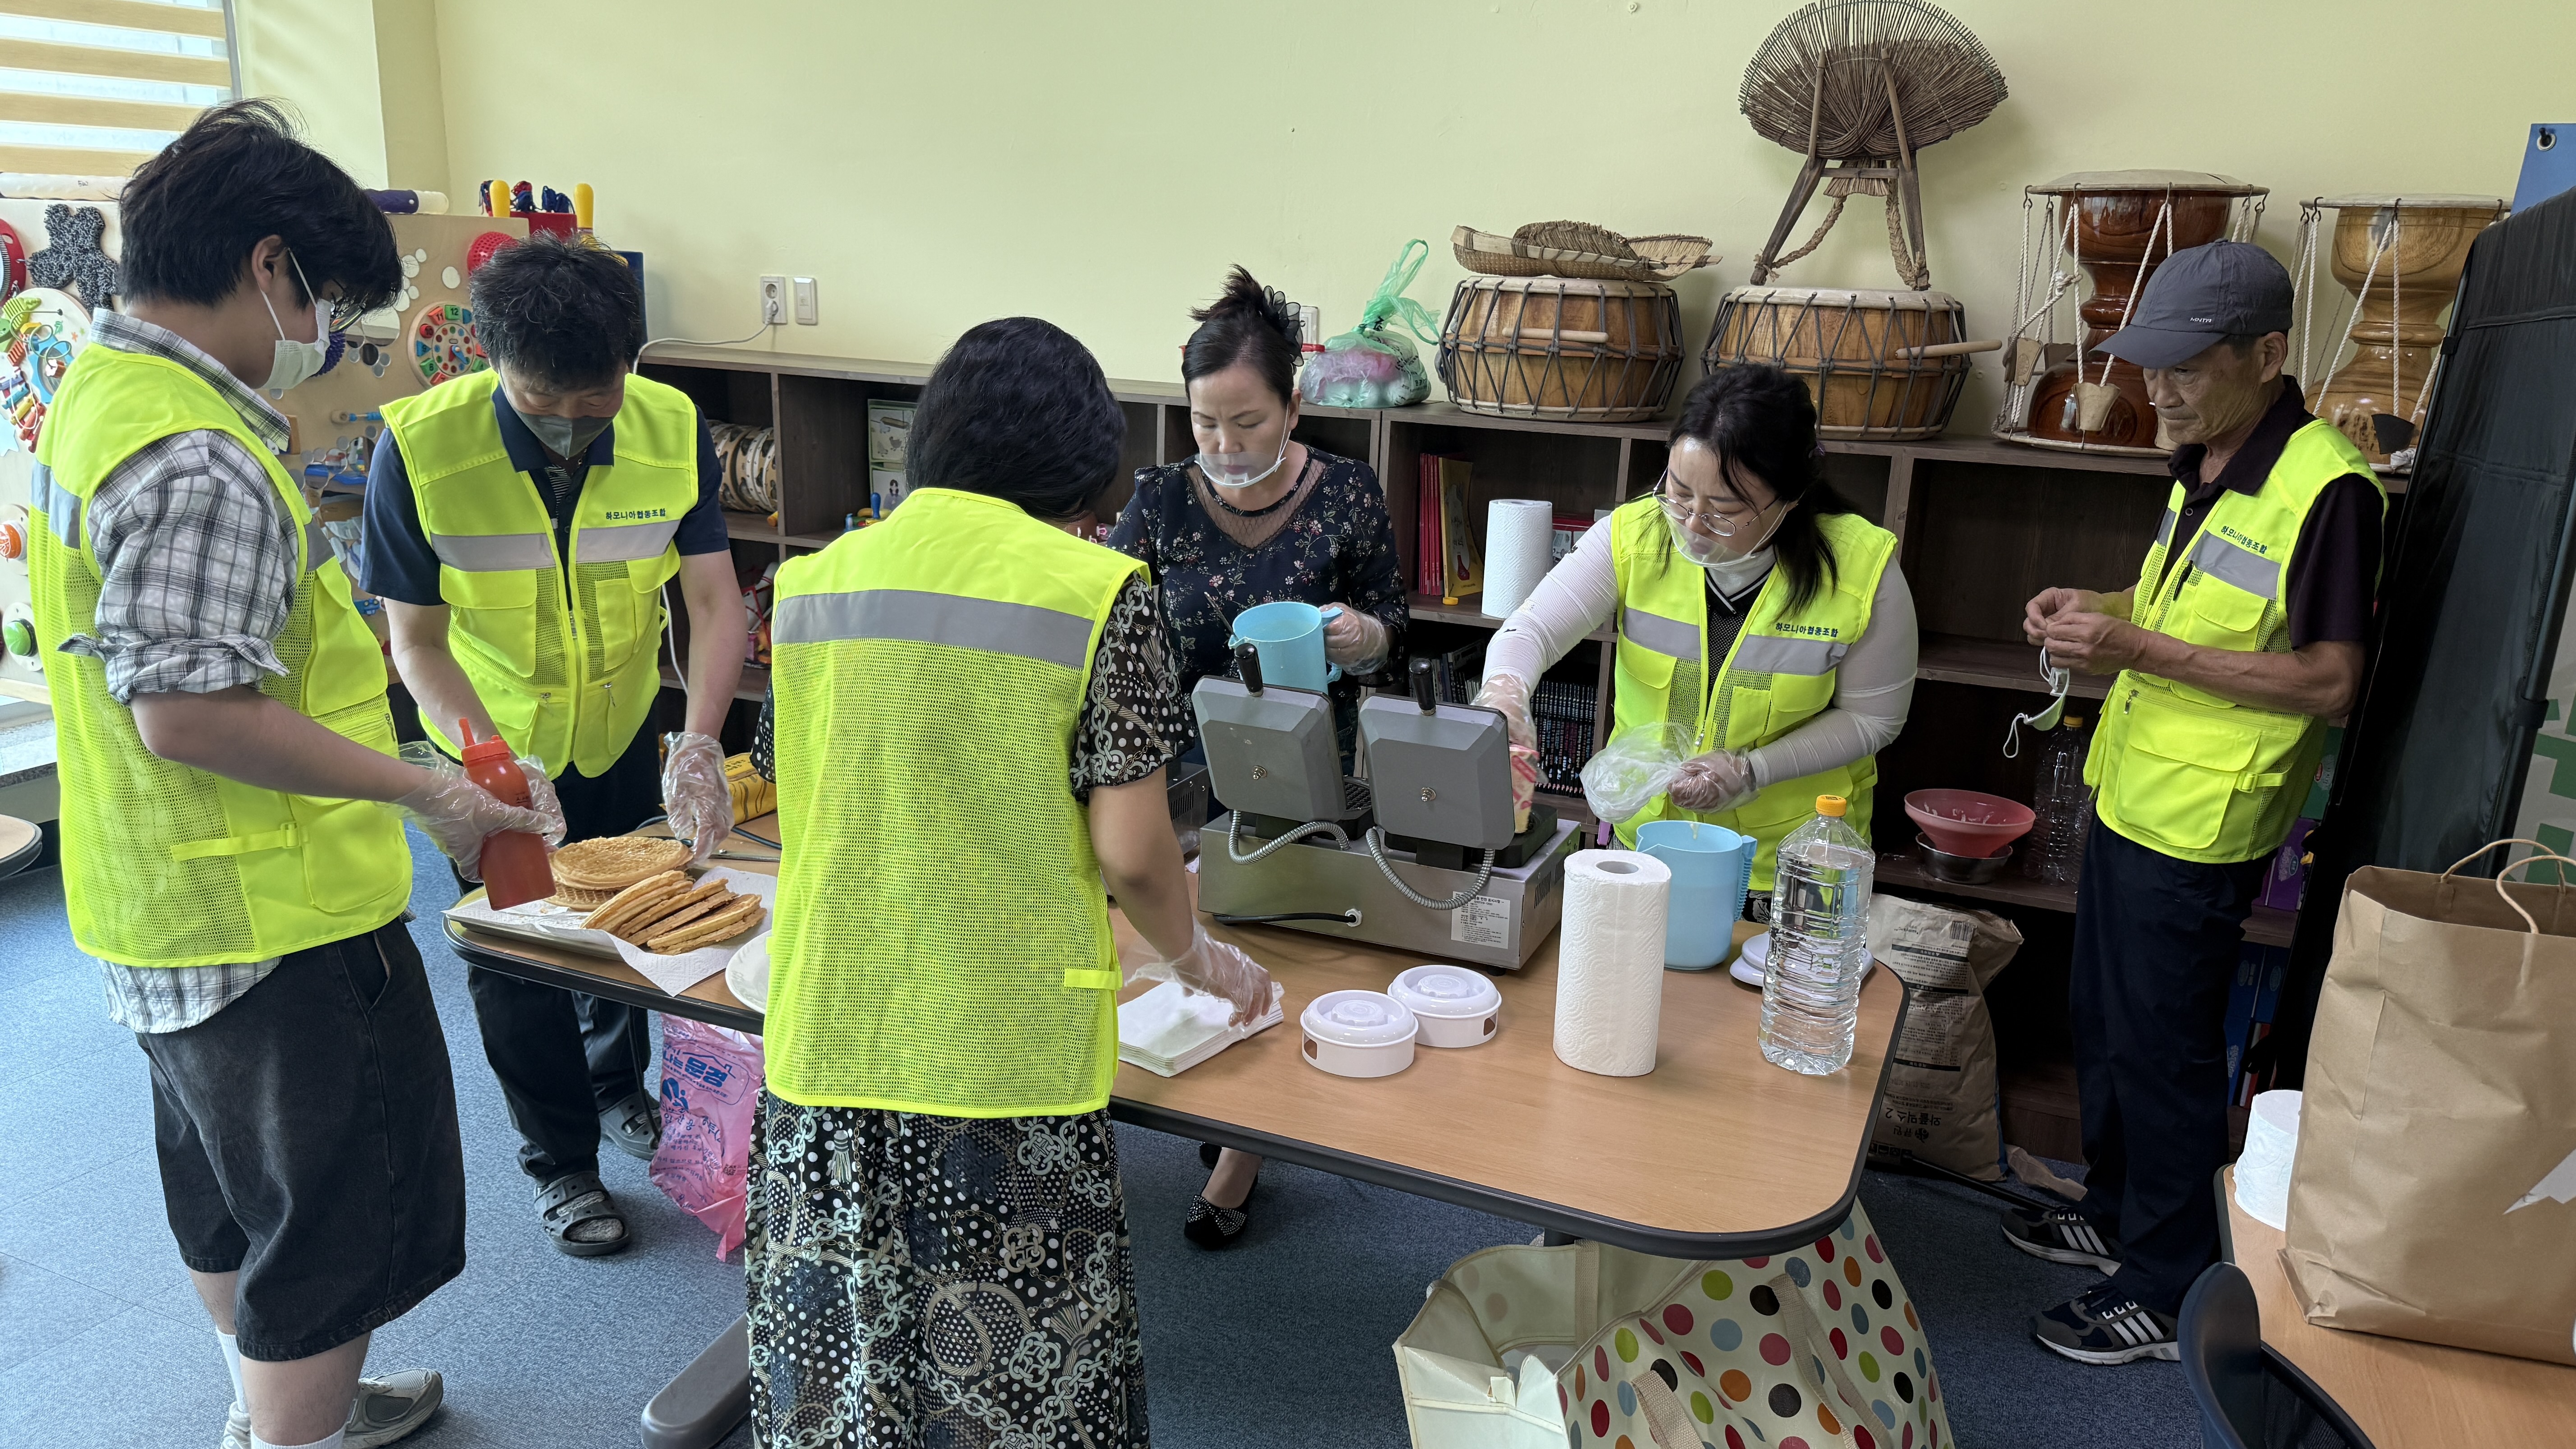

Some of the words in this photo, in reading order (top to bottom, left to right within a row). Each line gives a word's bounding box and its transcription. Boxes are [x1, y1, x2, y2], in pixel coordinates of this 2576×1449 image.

[436, 313, 443, 321] 11
[606, 508, 666, 520] 하모니아협동조합
[2221, 526, 2267, 554] 하모니아협동조합
[1776, 623, 1838, 637] 하모니아협동조합
[1886, 1108, 1894, 1119] 2
[1897, 1111, 1941, 1126] 와플믹스
[1893, 1126, 1913, 1138] 큐원
